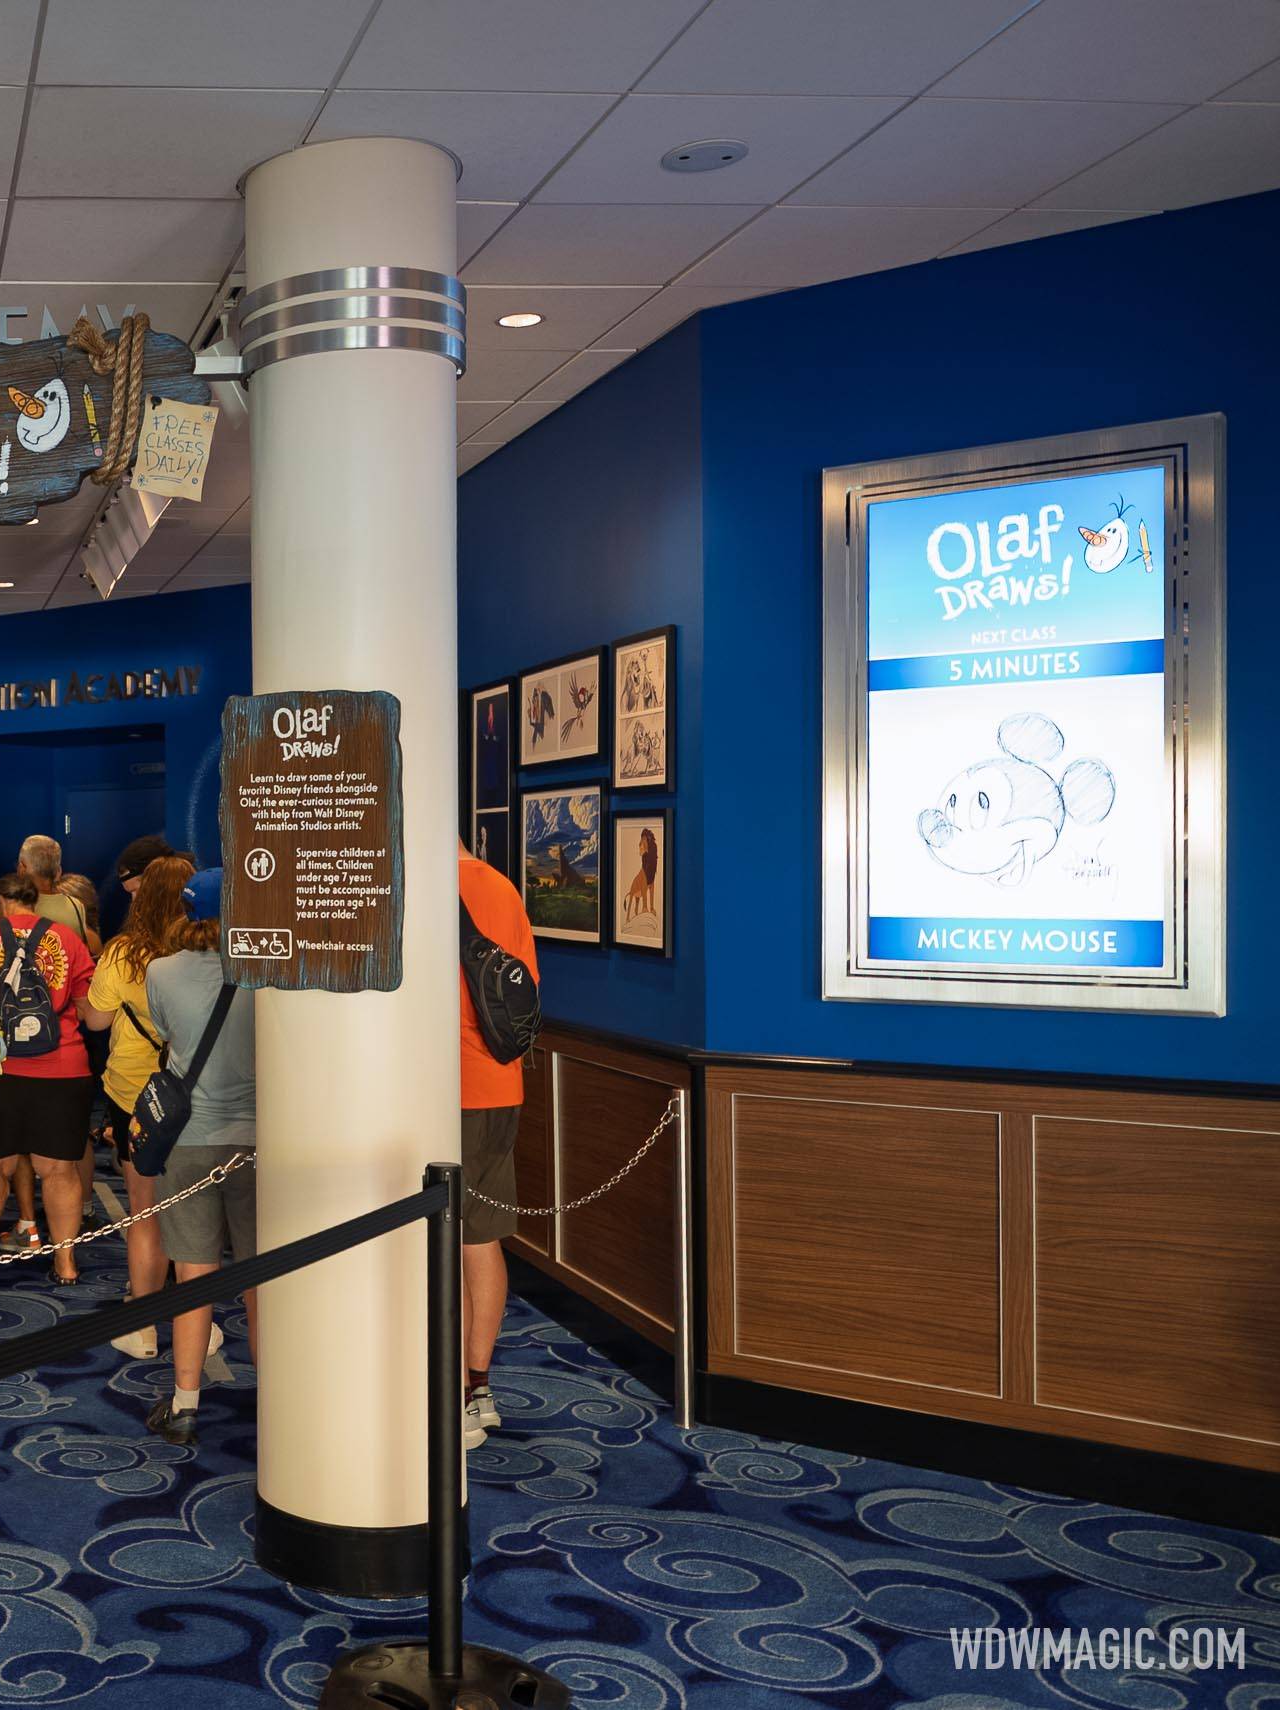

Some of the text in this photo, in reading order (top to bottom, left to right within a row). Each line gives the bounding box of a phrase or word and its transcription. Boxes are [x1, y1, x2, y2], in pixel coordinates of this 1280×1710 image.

[152, 414, 203, 437] FREE
[145, 432, 204, 455] CLASSES
[144, 449, 204, 479] DAILY!
[971, 626, 1057, 645] NEXT CLASS
[949, 651, 1081, 681] 5 MINUTES
[250, 771, 366, 783] Learn to draw some of your
[239, 783, 378, 796] favorite Disney friends alongside
[240, 797, 377, 808] Olaf, the ever-curious snowman,
[252, 808, 364, 821] with help from Walt Disney
[255, 821, 361, 831] Animation Studios artists.
[296, 848, 385, 860] Supervise children at
[296, 860, 373, 869] all times. Children
[296, 872, 372, 885] under age 7 years
[296, 885, 391, 897] must be accompanied
[296, 896, 307, 909] by
[315, 899, 345, 909] person
[347, 900, 363, 910] age
[366, 897, 376, 907] 14
[297, 909, 357, 921] years or older.
[296, 940, 374, 951] Wheelchair access
[917, 927, 1118, 953] MICKEY MOUSE
